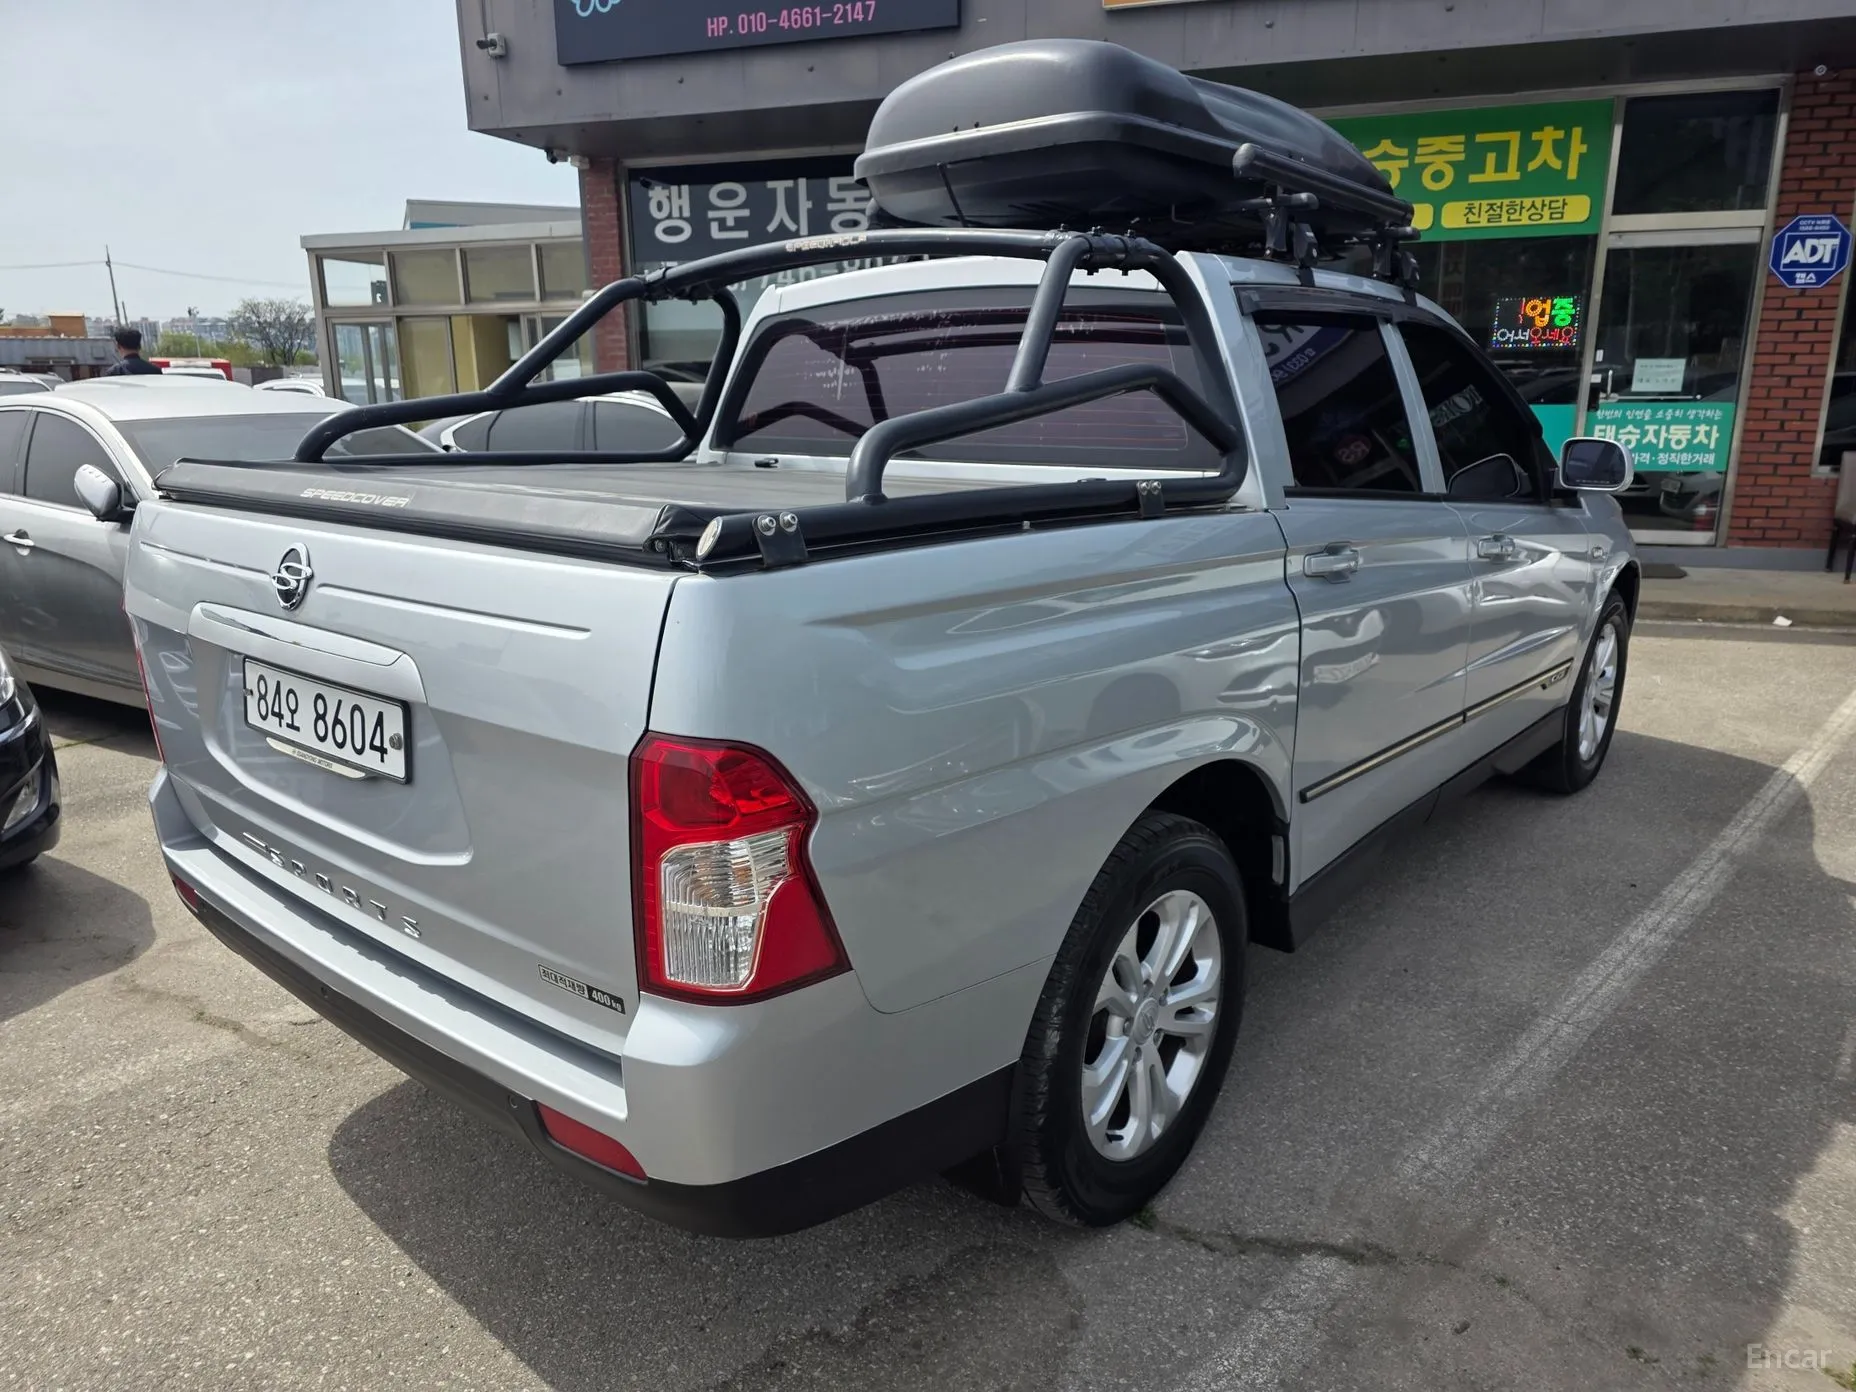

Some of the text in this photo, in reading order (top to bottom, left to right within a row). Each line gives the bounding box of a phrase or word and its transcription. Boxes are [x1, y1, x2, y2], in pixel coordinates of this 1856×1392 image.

[707, 1, 876, 37] HP. 010-4661-2147
[1463, 197, 1568, 225] 친절한상담
[1782, 238, 1840, 264] ADT
[1497, 326, 1574, 345] 어서오세요
[1655, 408, 1684, 420] 소중히
[1593, 423, 1720, 450] 태승자동차
[300, 487, 411, 508] SPEEDCOVER
[257, 674, 388, 764] 84오 8604
[269, 847, 421, 939] SPORTS
